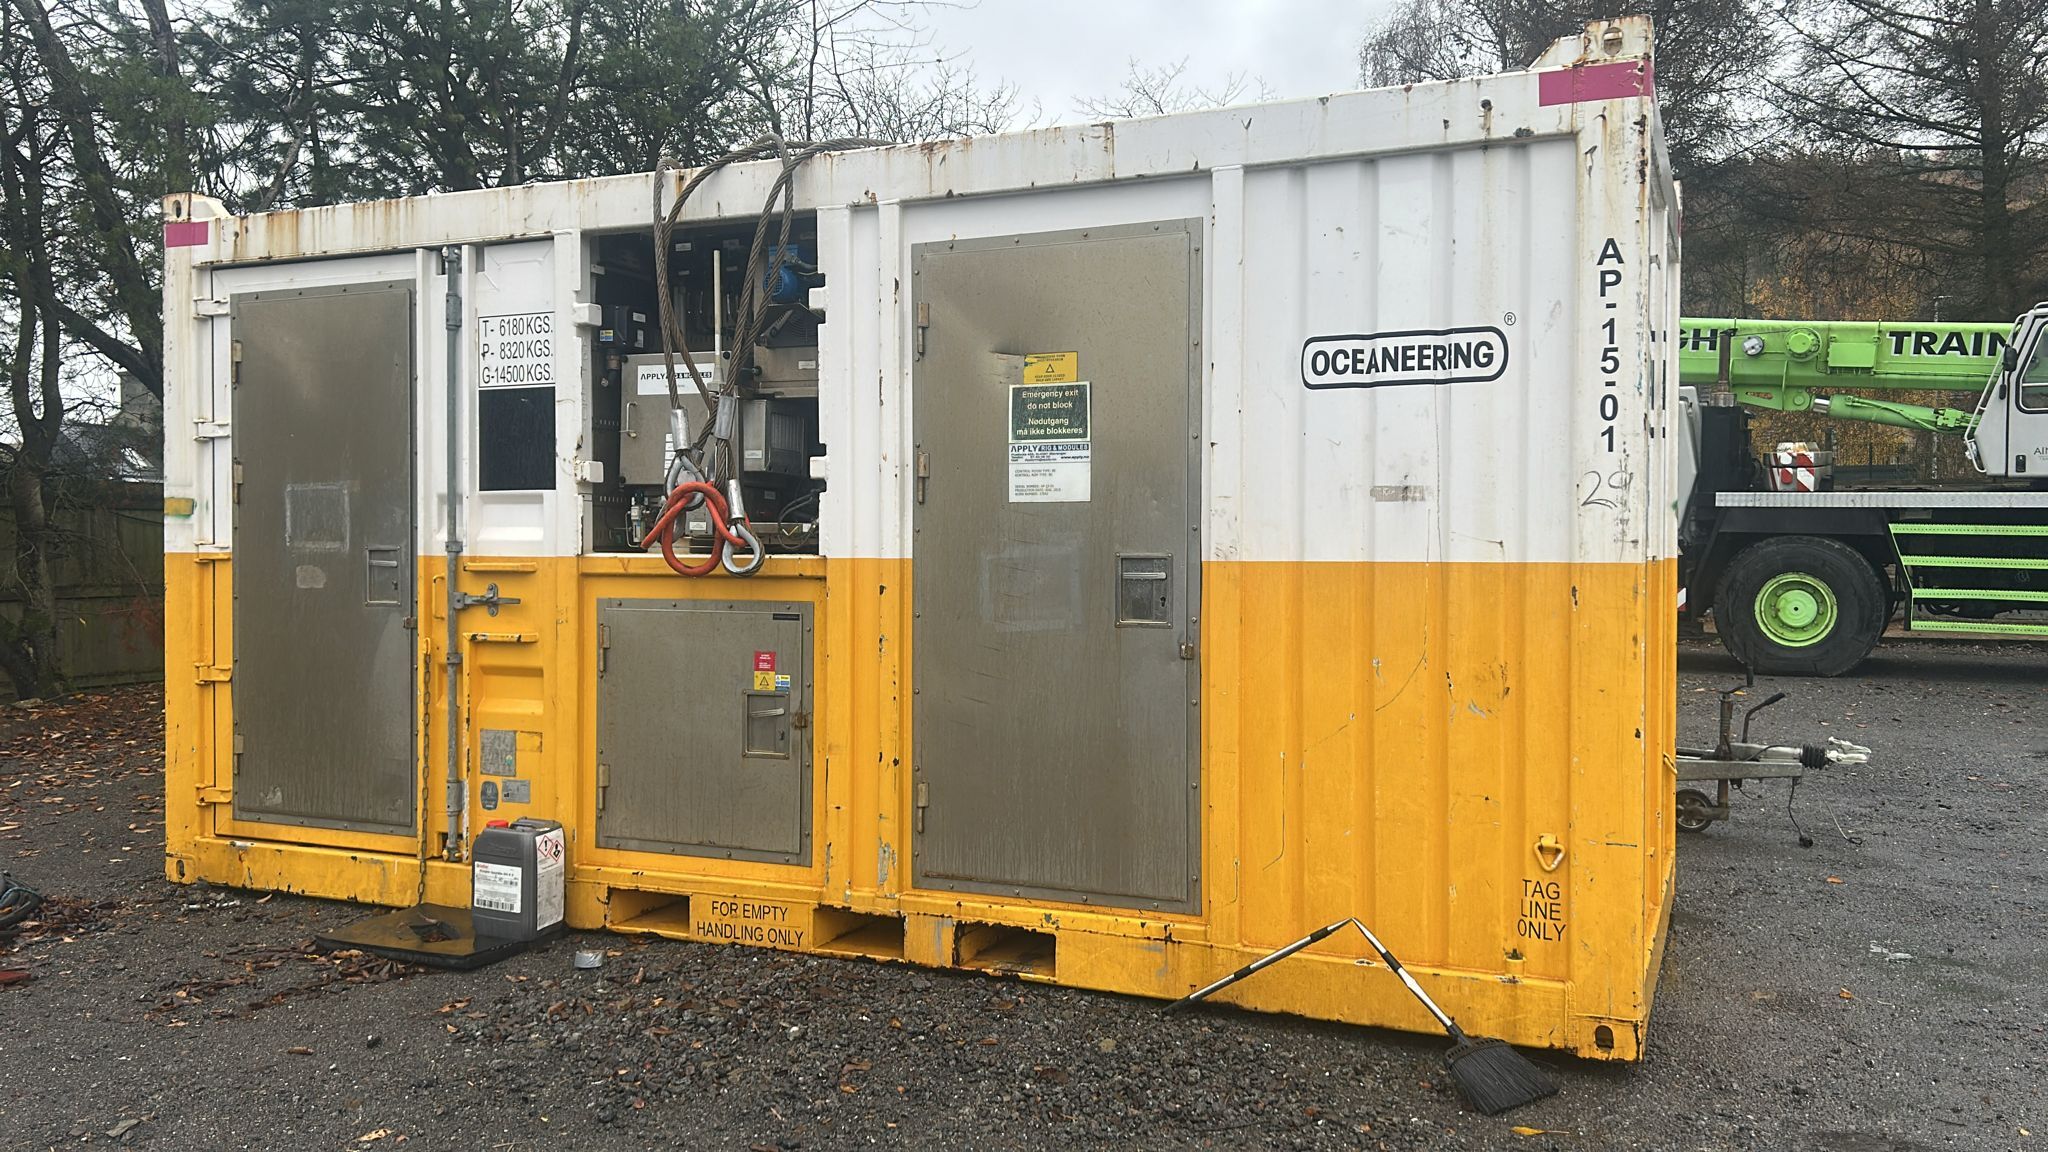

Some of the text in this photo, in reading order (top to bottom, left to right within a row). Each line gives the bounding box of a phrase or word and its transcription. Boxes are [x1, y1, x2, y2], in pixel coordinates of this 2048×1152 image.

[1597, 237, 1624, 453] AP-15-01
[1310, 340, 1495, 377] OCEANEERING
[1022, 388, 1079, 399] Emergency exit
[1016, 426, 1083, 435] må ikke blokkeres
[1028, 418, 1069, 426] Nødutgang
[1522, 879, 1560, 900] TAG
[712, 901, 788, 921] FOR EMPTY
[1521, 899, 1561, 921] LINE
[697, 921, 803, 947] HANDLING ONLY
[1518, 919, 1566, 941] ONLY
